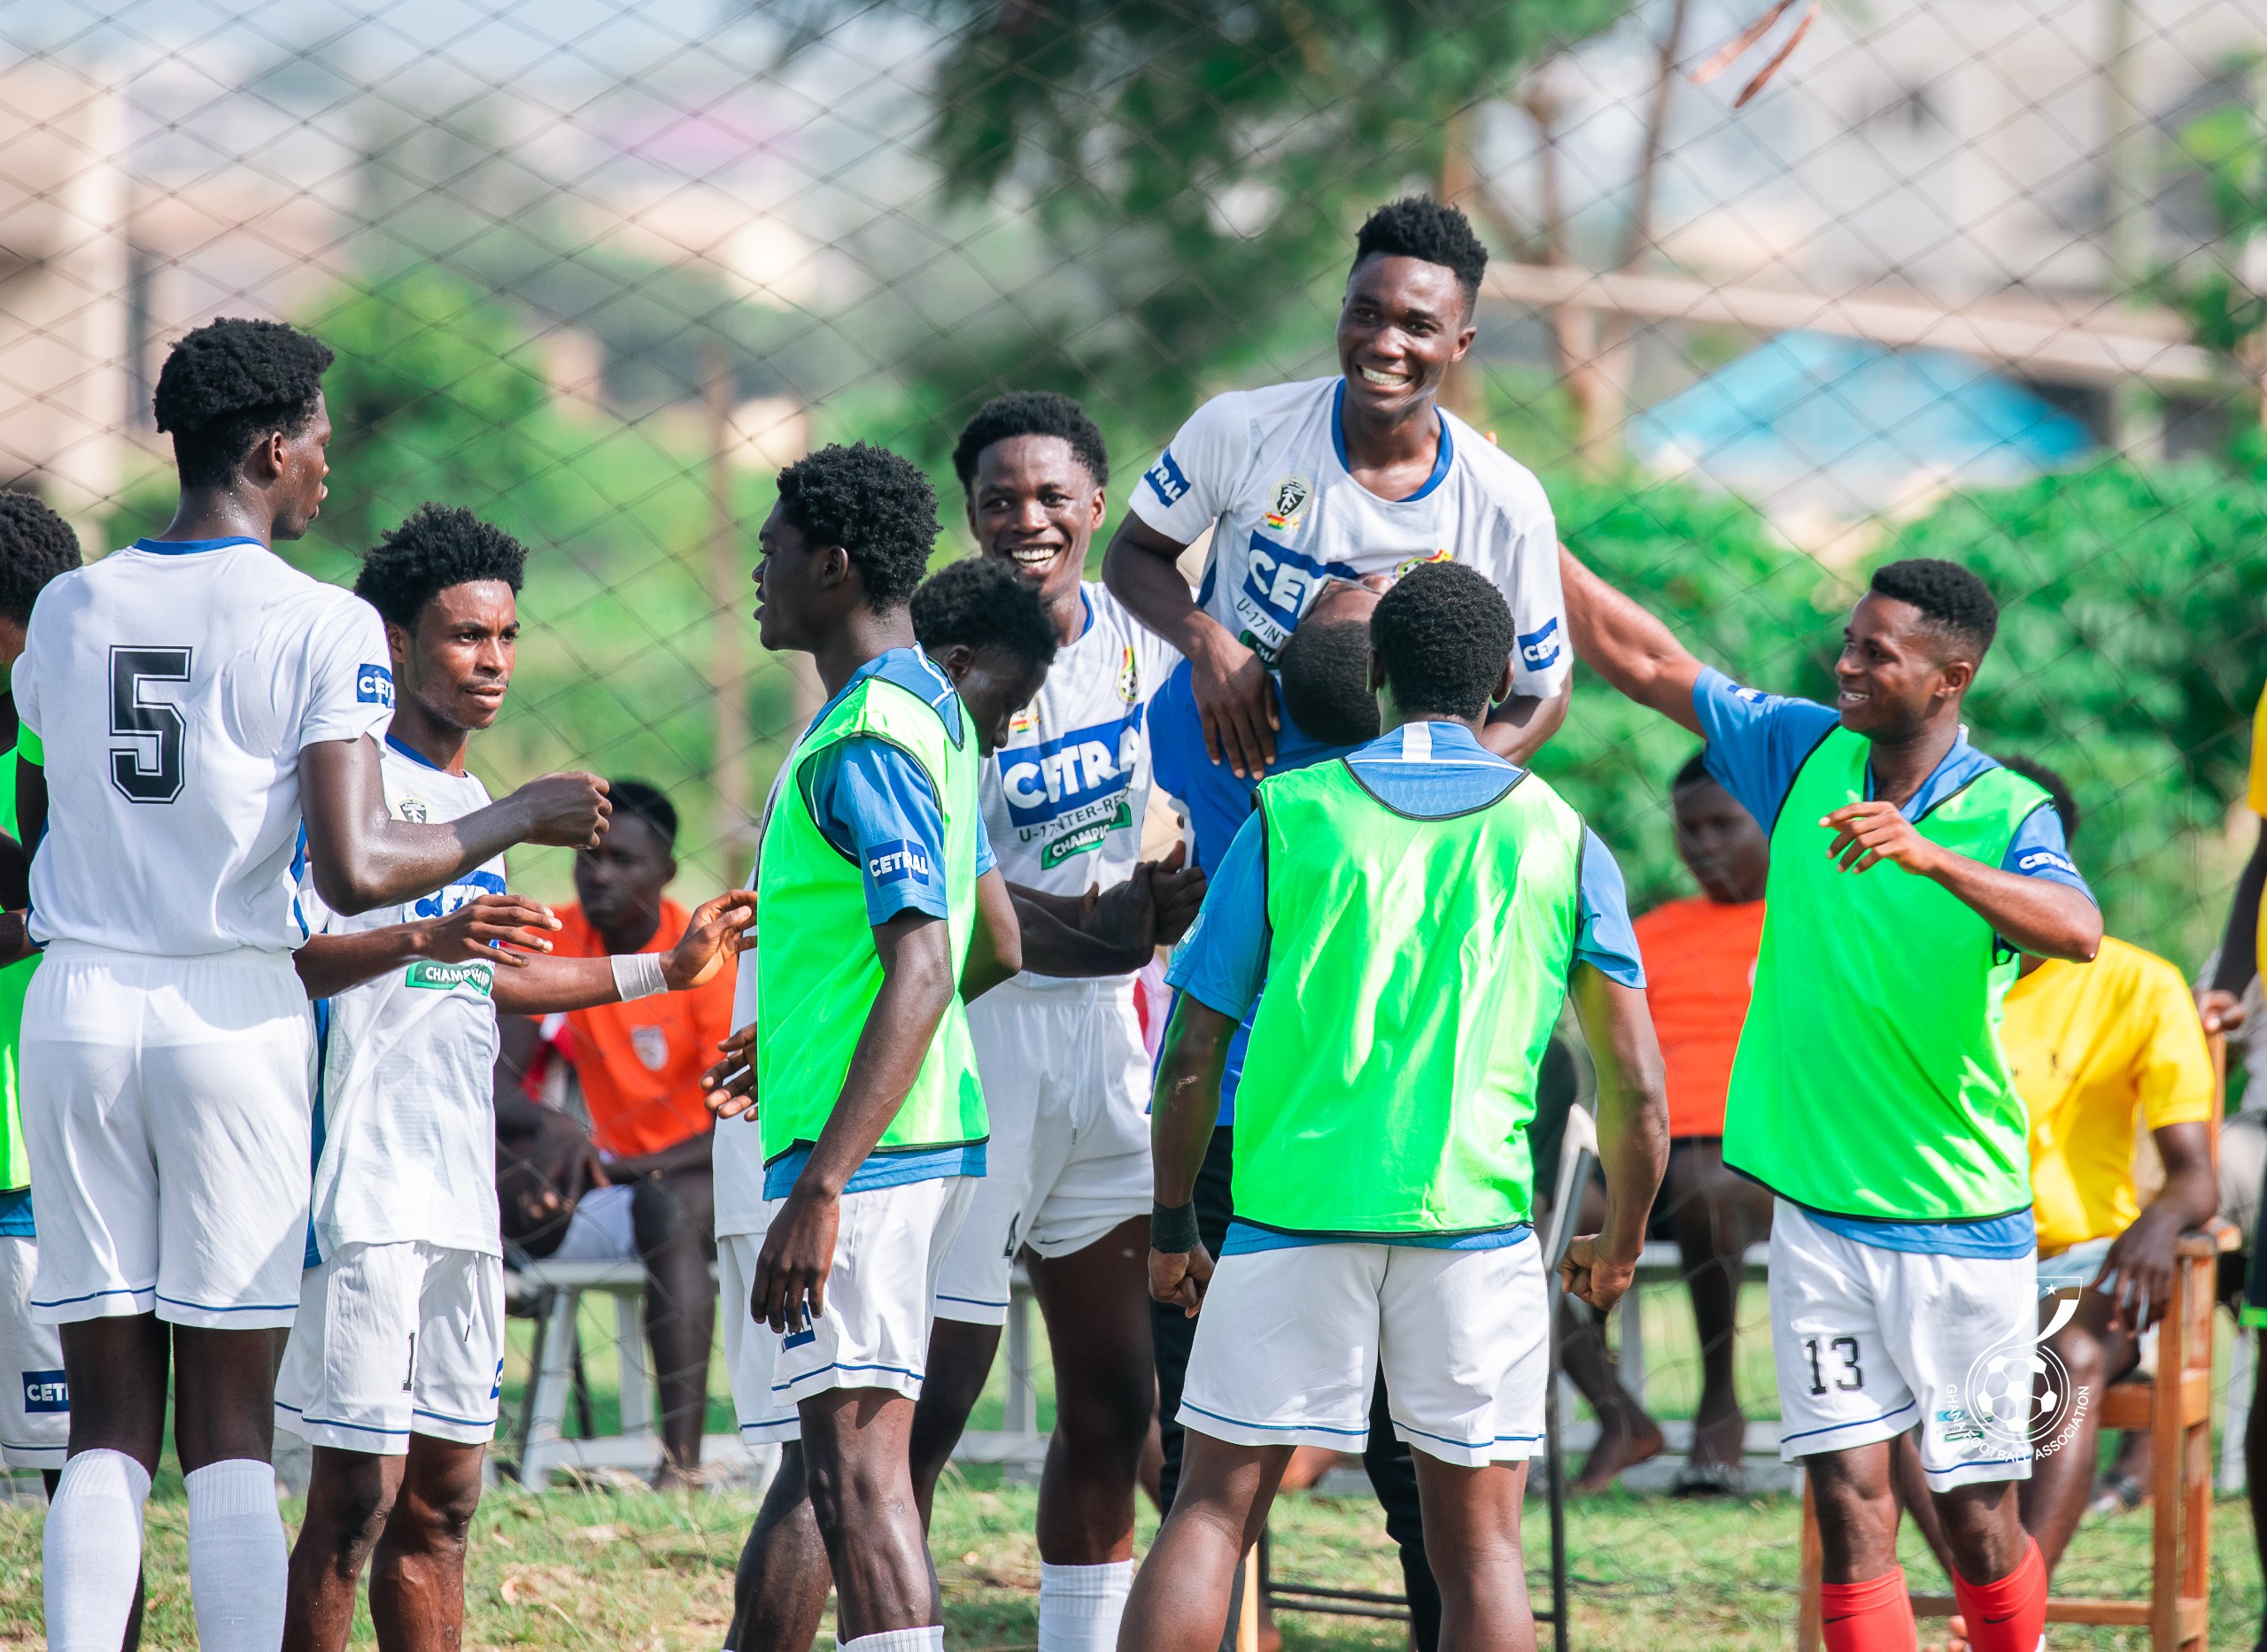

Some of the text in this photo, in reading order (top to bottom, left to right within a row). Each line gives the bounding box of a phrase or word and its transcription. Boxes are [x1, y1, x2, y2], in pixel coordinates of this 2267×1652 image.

[1235, 598, 1267, 628] U-17
[109, 645, 193, 804] 5
[1018, 813, 1056, 843] U-17
[869, 851, 929, 877] CETRAL
[1803, 1335, 1865, 1396] 13
